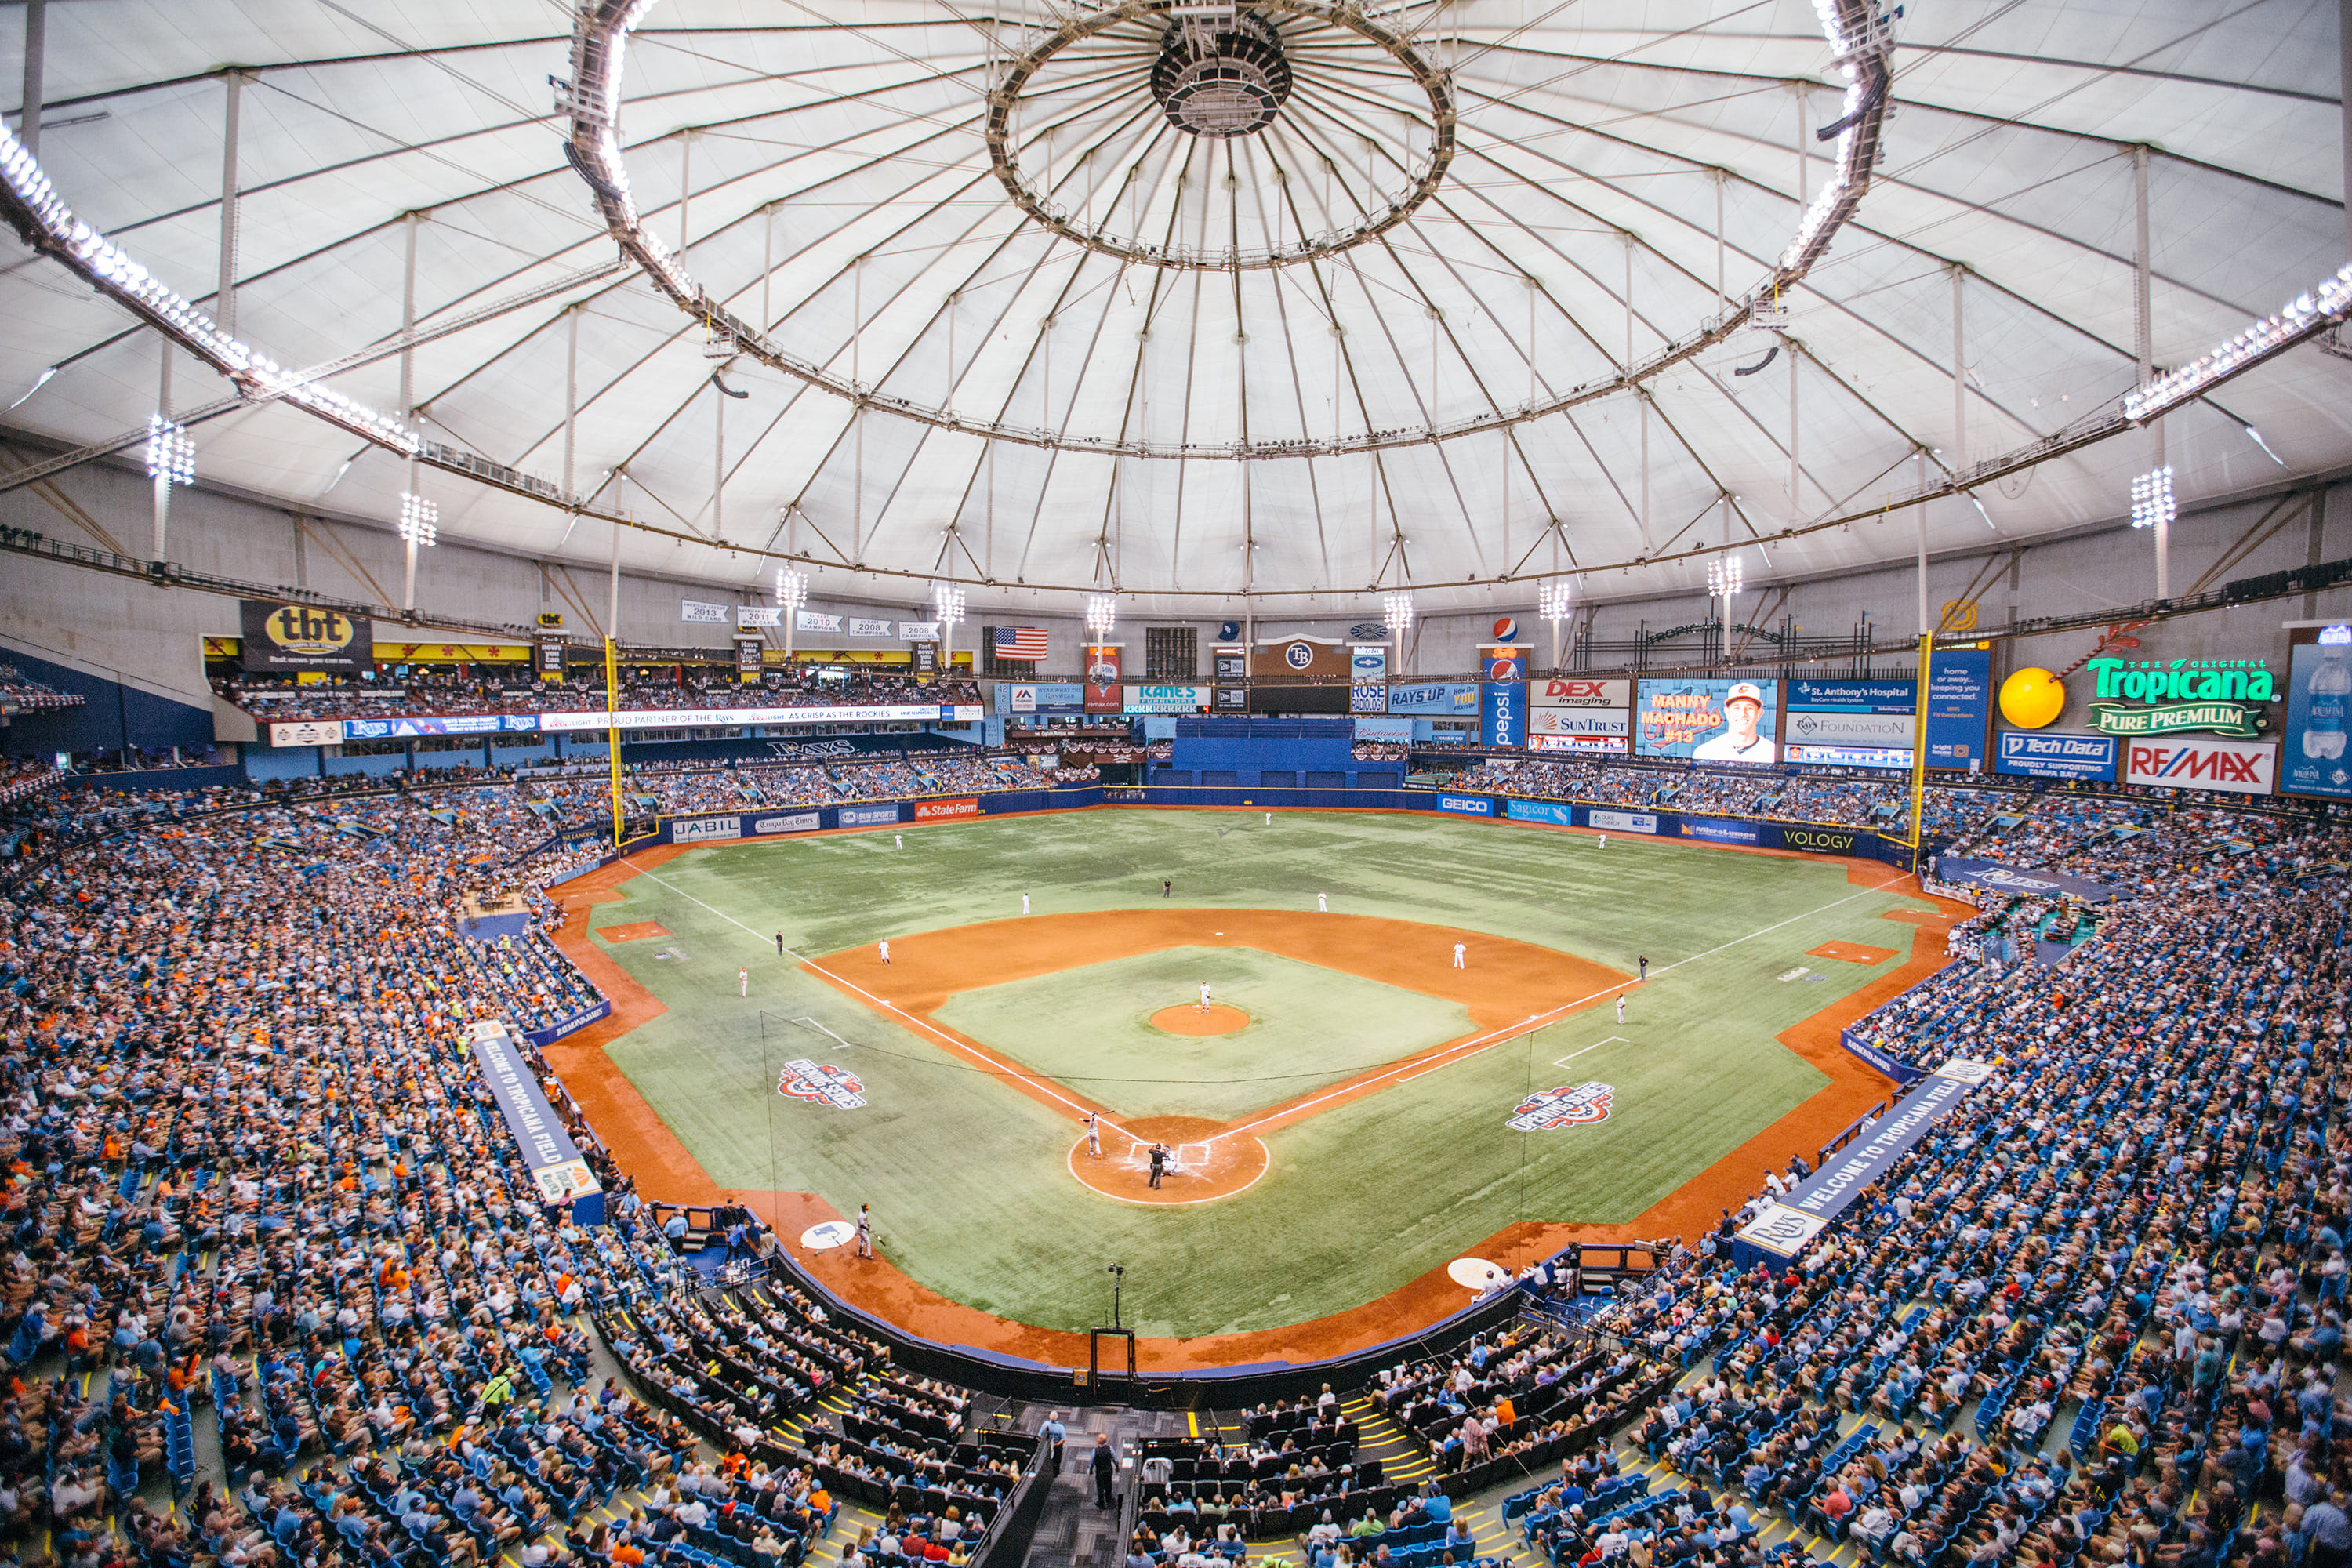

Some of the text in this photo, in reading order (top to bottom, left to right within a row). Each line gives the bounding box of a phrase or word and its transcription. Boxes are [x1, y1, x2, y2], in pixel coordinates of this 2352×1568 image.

[694, 608, 717, 617] 2013
[278, 608, 343, 641] tbt
[1291, 648, 1308, 664] TB
[2129, 659, 2266, 670] THE ORIGINAL
[1931, 684, 1963, 693] keeping
[2087, 658, 2274, 704] Tropicana
[1352, 686, 1385, 698] ROSE
[1391, 688, 1446, 706] RAYS UP
[1544, 681, 1608, 698] DEX
[1811, 688, 1909, 699] St. Anthony's Hospital
[1352, 699, 1385, 711] RADIOLOGY
[1454, 693, 1475, 706] YOU
[1559, 696, 1612, 706] imaging
[1652, 695, 1712, 709] MANNY
[597, 715, 633, 726] PROUD
[634, 715, 678, 724] PARTNER
[680, 714, 693, 723] OF
[801, 710, 825, 720] CRISP
[1494, 691, 1514, 746] pepsi
[1641, 711, 1722, 727] MACHADO
[2100, 706, 2244, 731] PURE PREMIUM
[1356, 728, 1410, 738] Budweiser
[1664, 730, 1694, 743] #13
[2024, 738, 2107, 757] Tech Data
[2007, 760, 2103, 773] PROUDLY SUPPORTING
[2129, 746, 2264, 784] RE/MAX
[2029, 768, 2079, 779] TAMPA BAY
[931, 803, 977, 816] State Farm
[1442, 797, 1488, 812] GEICO
[1510, 801, 1550, 816] Sagicor
[872, 810, 897, 818] SPORTS
[675, 820, 739, 835] JABIL
[760, 819, 782, 829] Tampa
[782, 818, 794, 827] Bay
[572, 831, 598, 840] LANDING
[1784, 829, 1853, 849] VOLOGY
[556, 1007, 604, 1036] RAYMOND JAMES
[482, 1040, 511, 1075] WELCOME
[1846, 1038, 1892, 1073] RAYMOND JAMES
[500, 1071, 520, 1084] TO
[506, 1081, 546, 1135] TROPICANA
[533, 1132, 563, 1165] FIELD
[1798, 1079, 1960, 1211] WELCOME TO TROPICANA FIELD
